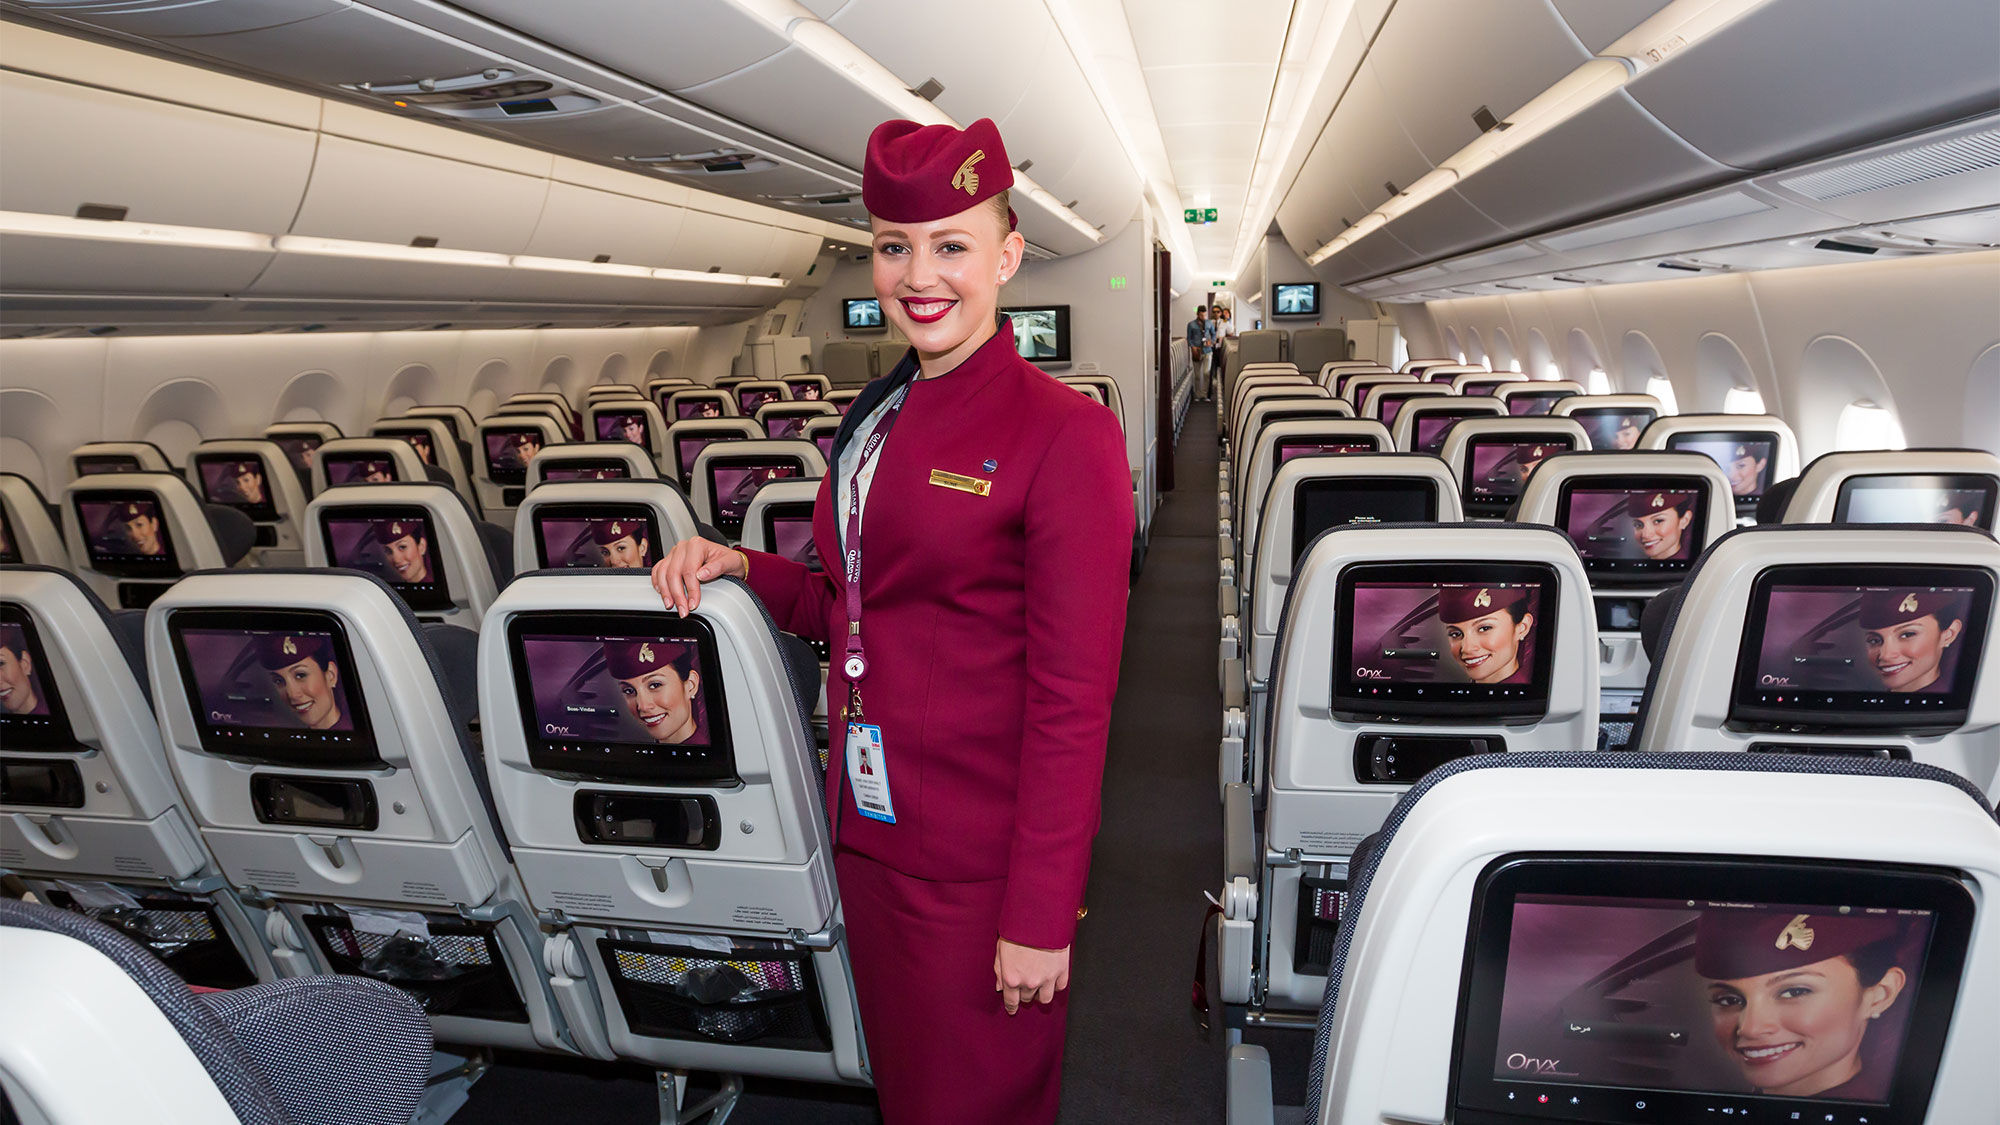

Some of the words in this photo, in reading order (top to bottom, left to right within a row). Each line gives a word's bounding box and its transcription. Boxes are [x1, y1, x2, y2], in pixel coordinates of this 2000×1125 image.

[1356, 667, 1382, 680] Oryx
[1761, 674, 1789, 686] Oryx
[210, 711, 232, 723] Oryx
[545, 723, 569, 736] Oryx
[1570, 1023, 1591, 1033] مرحبا
[1506, 1052, 1560, 1073] Oryx
